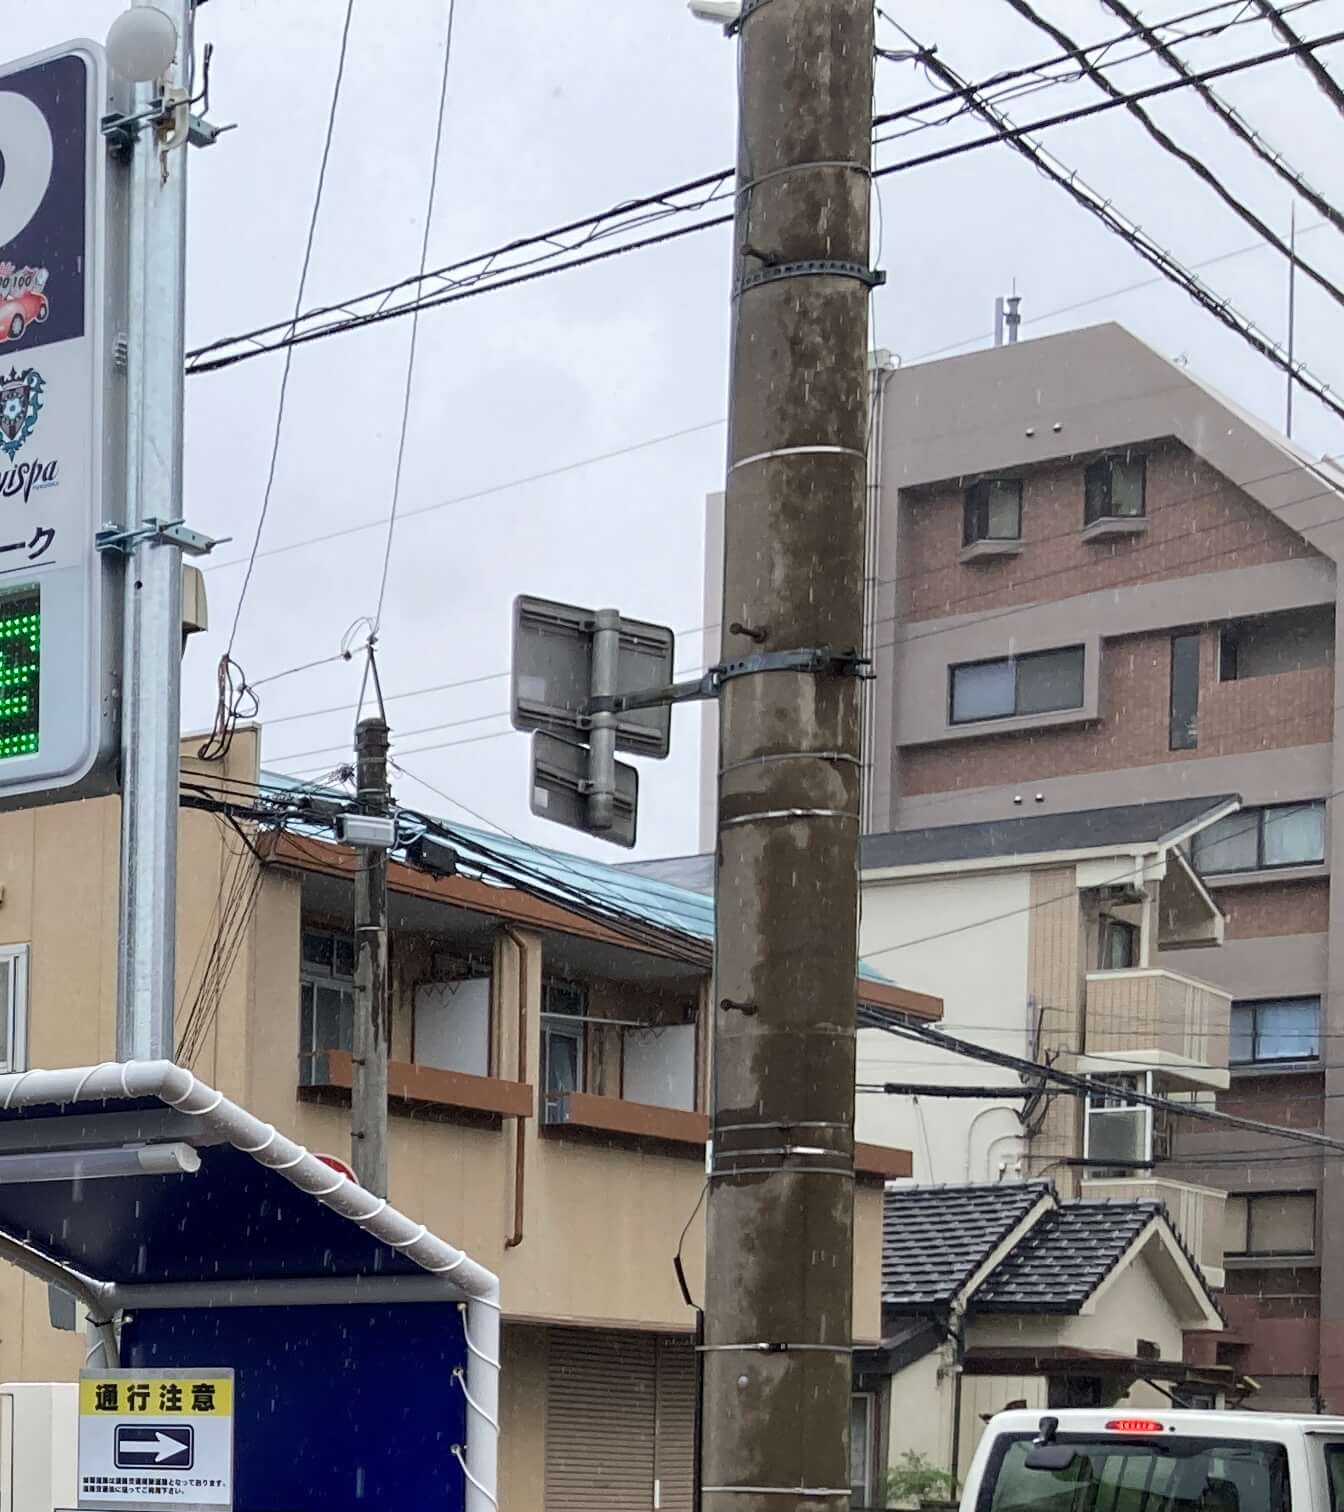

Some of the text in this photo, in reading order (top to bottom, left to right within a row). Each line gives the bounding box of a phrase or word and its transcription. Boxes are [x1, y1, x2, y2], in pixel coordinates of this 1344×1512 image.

[13, 274, 32, 290] 100
[94, 1383, 217, 1413] 通行注意
